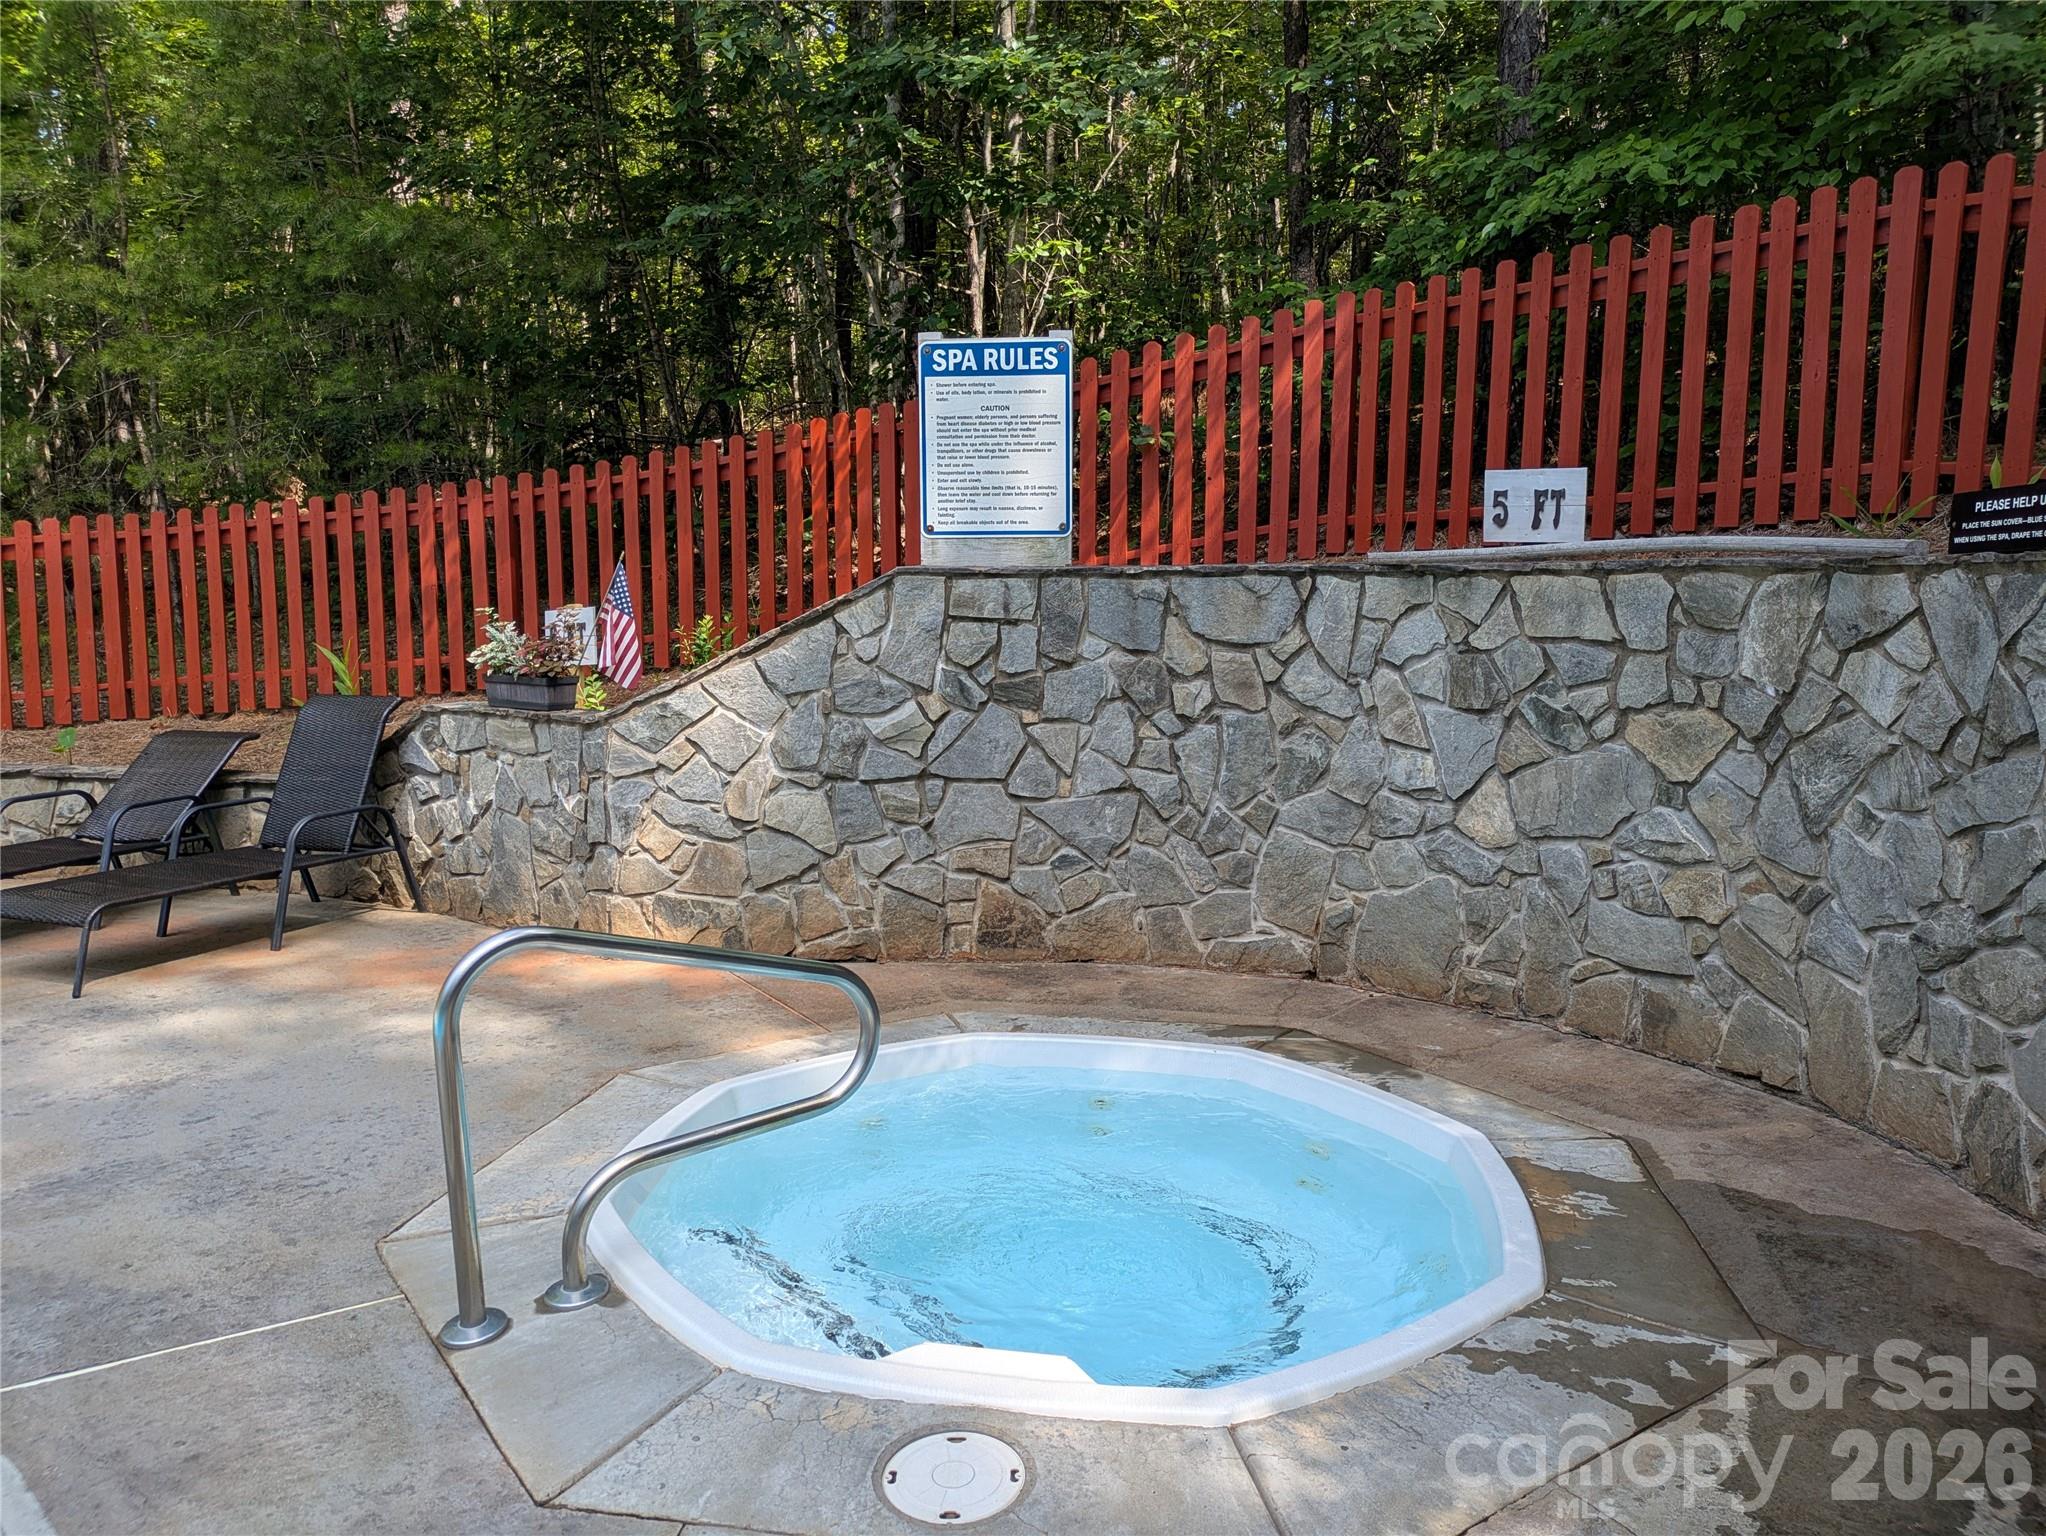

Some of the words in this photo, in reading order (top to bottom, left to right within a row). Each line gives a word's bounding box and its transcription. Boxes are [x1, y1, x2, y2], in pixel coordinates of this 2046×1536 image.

[932, 348, 978, 372] SPA
[984, 346, 1059, 371] RULES
[1492, 489, 1508, 529] 5
[1531, 488, 1566, 530] FT
[1975, 498, 2012, 513] PLEASE
[2012, 495, 2039, 509] HELP
[1961, 521, 1979, 530] PLACE
[1980, 520, 1990, 528] THE
[1991, 519, 2003, 527] SUN
[1954, 536, 1969, 544] WHEN
[1969, 535, 1986, 543] USING
[1987, 533, 1998, 541] THE
[1998, 533, 2010, 541] SPA,
[2011, 531, 2031, 540] DRAPE
[2031, 529, 2043, 538] THE
